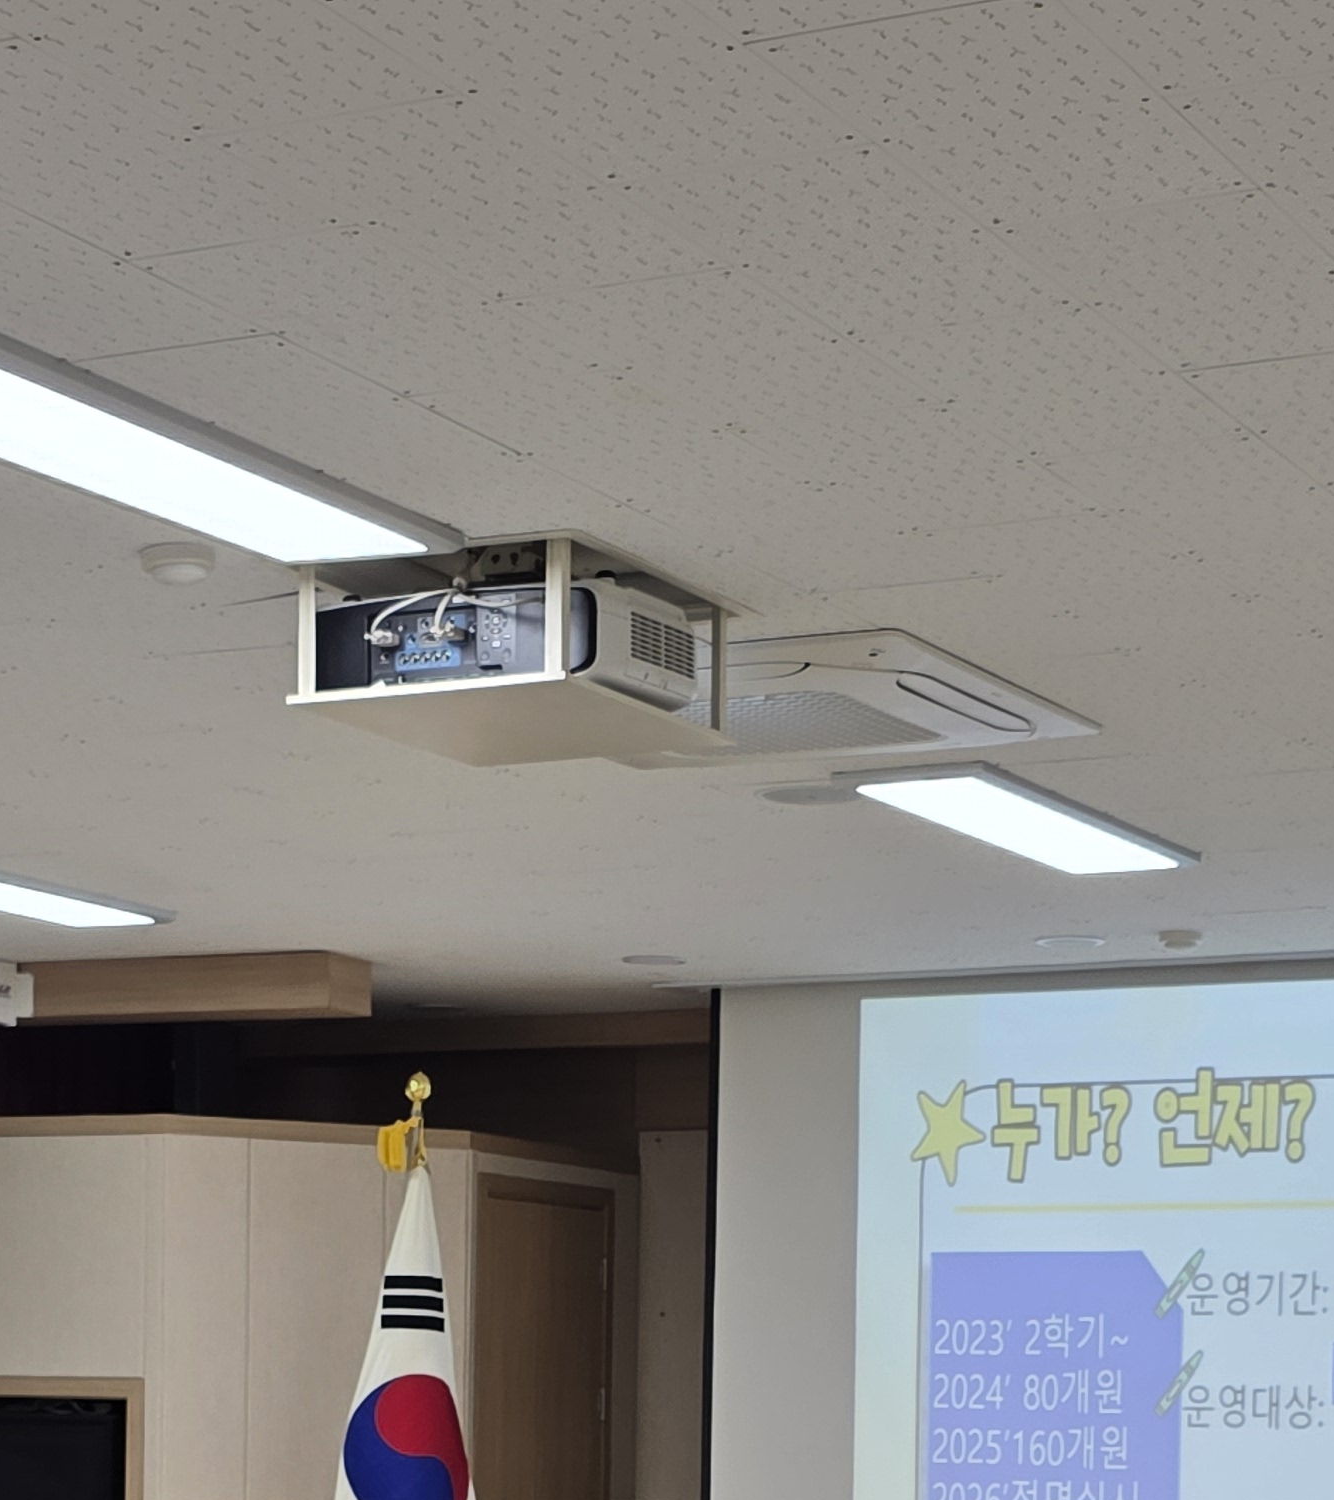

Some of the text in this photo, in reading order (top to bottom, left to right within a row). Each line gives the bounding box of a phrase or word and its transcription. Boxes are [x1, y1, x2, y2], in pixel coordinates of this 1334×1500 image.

[990, 1066, 1316, 1183] 누가? 언제?
[1185, 1268, 1331, 1317] 운영기간:
[1024, 1313, 1129, 1357] 2학기~
[1023, 1370, 1123, 1414] 80개원
[1181, 1383, 1326, 1430] 운영대상:
